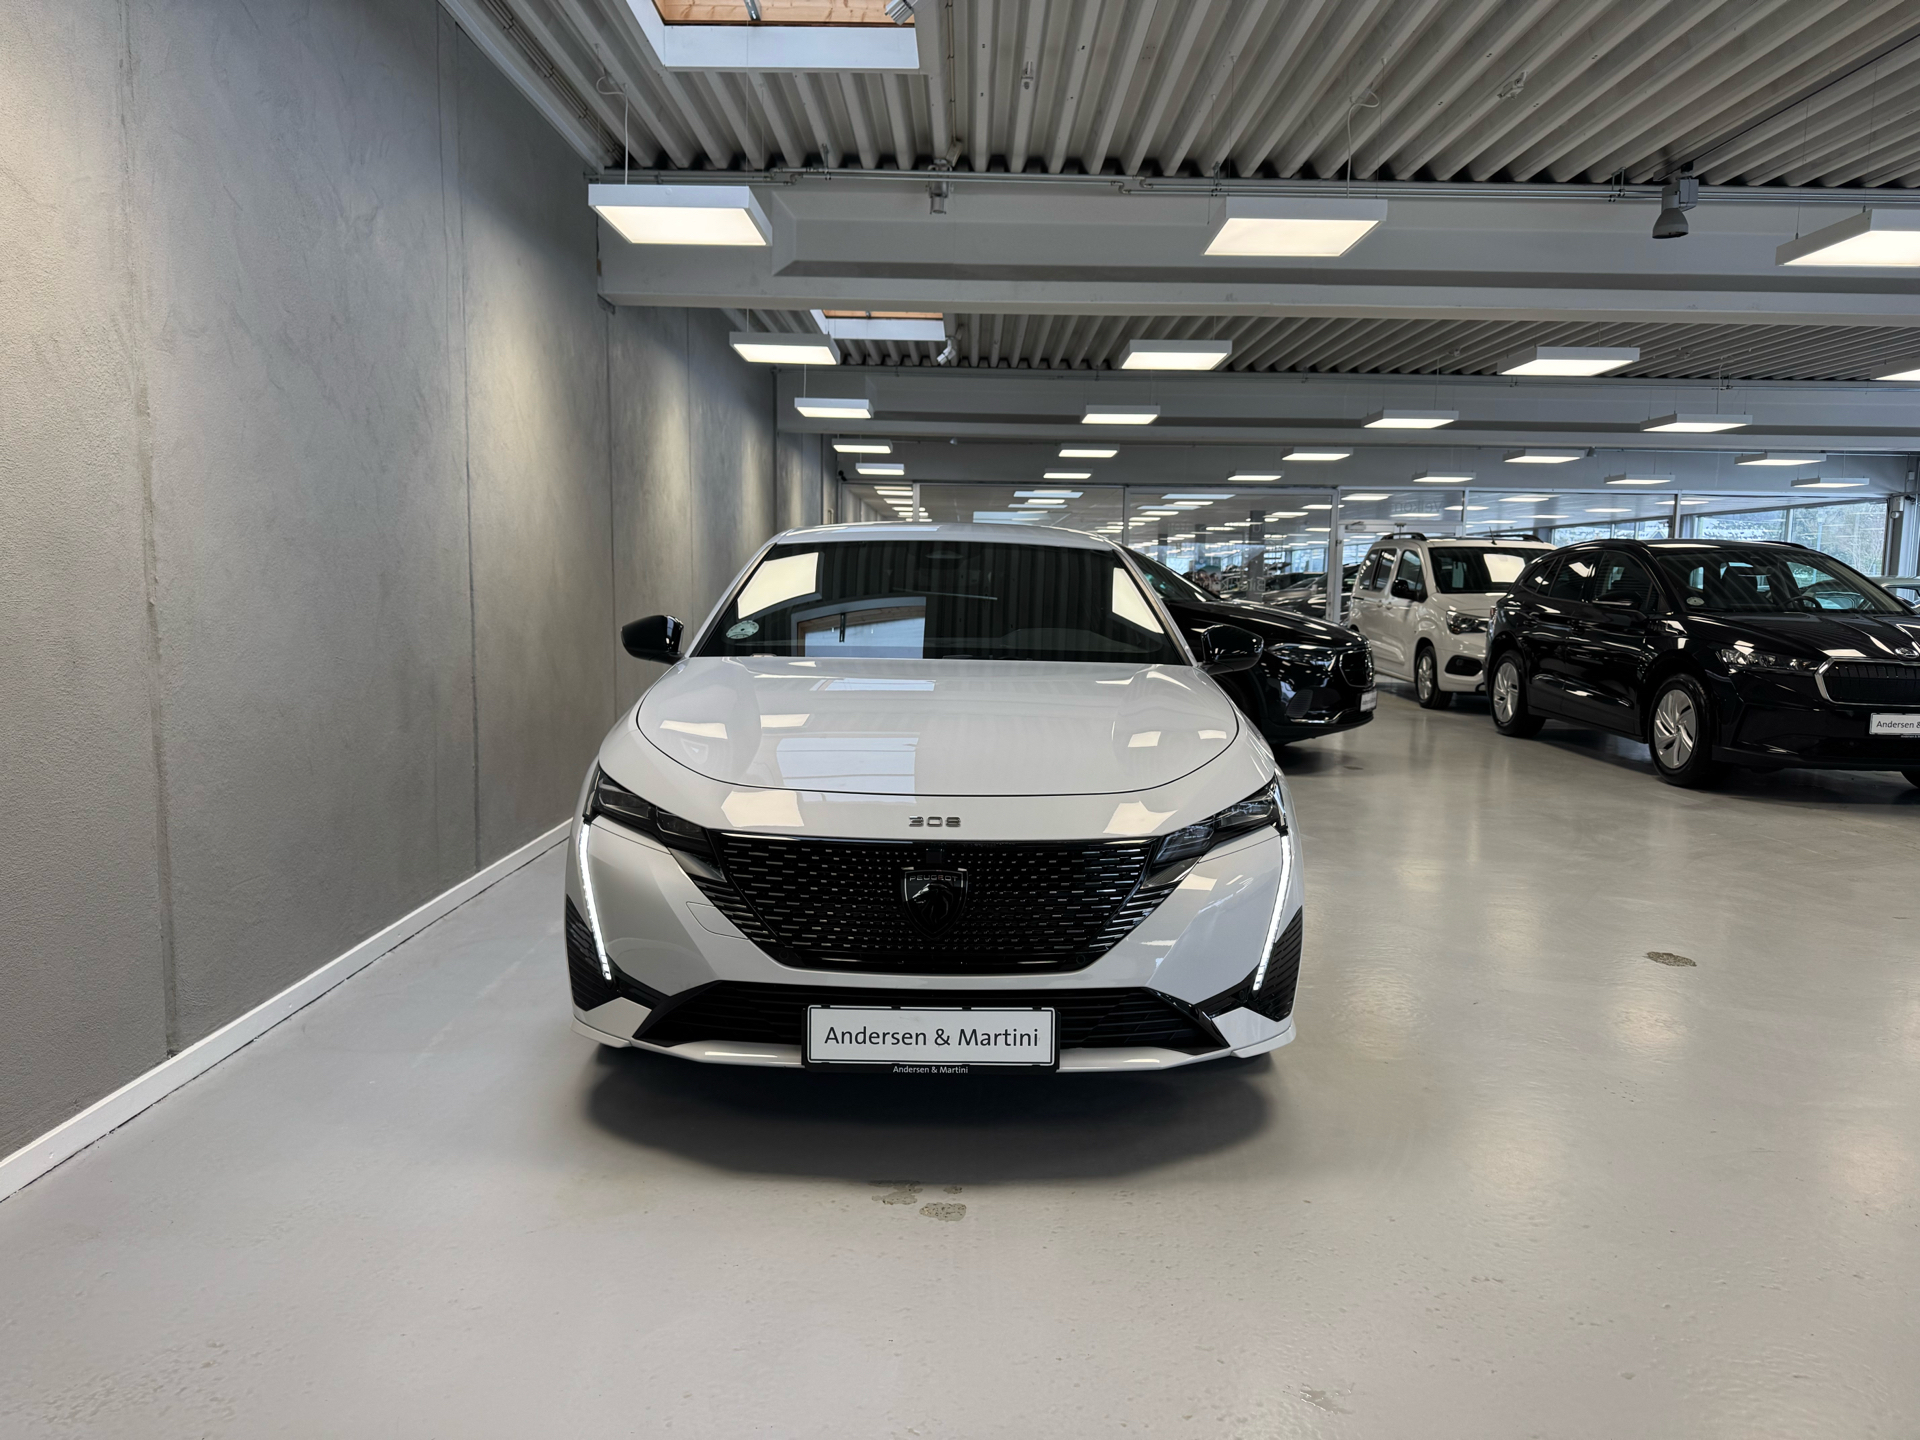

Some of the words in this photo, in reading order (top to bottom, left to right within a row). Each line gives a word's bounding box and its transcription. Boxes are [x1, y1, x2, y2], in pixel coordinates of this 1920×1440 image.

[1876, 720, 1914, 728] Andersen
[908, 816, 962, 828] 308
[909, 874, 958, 882] PEUGEOT
[824, 1026, 927, 1046] Andersen
[934, 1028, 951, 1046] &
[957, 1028, 1038, 1047] Martini
[892, 1065, 929, 1074] Andersen
[931, 1066, 938, 1074] &
[939, 1066, 969, 1074] Martini
